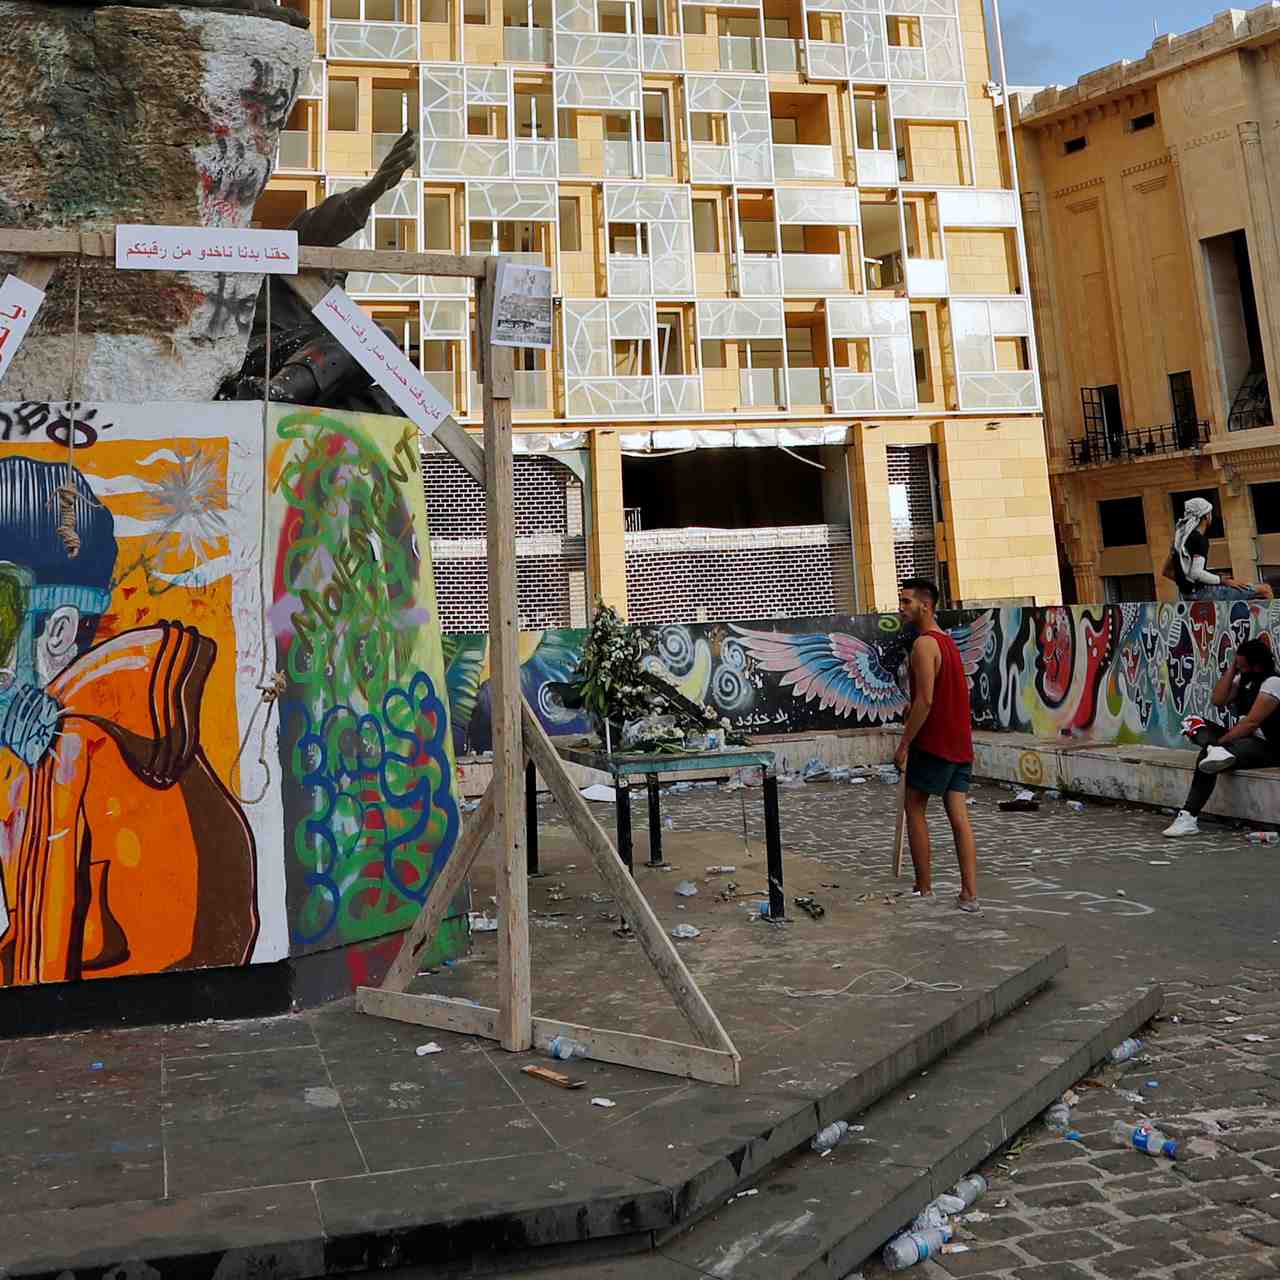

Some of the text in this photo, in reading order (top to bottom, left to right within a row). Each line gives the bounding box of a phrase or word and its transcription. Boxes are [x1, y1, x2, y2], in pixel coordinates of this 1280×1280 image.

[172, 242, 191, 260] من
[238, 245, 260, 262] بدنا
[264, 246, 290, 260] حقنا
[0, 304, 27, 320] يا
